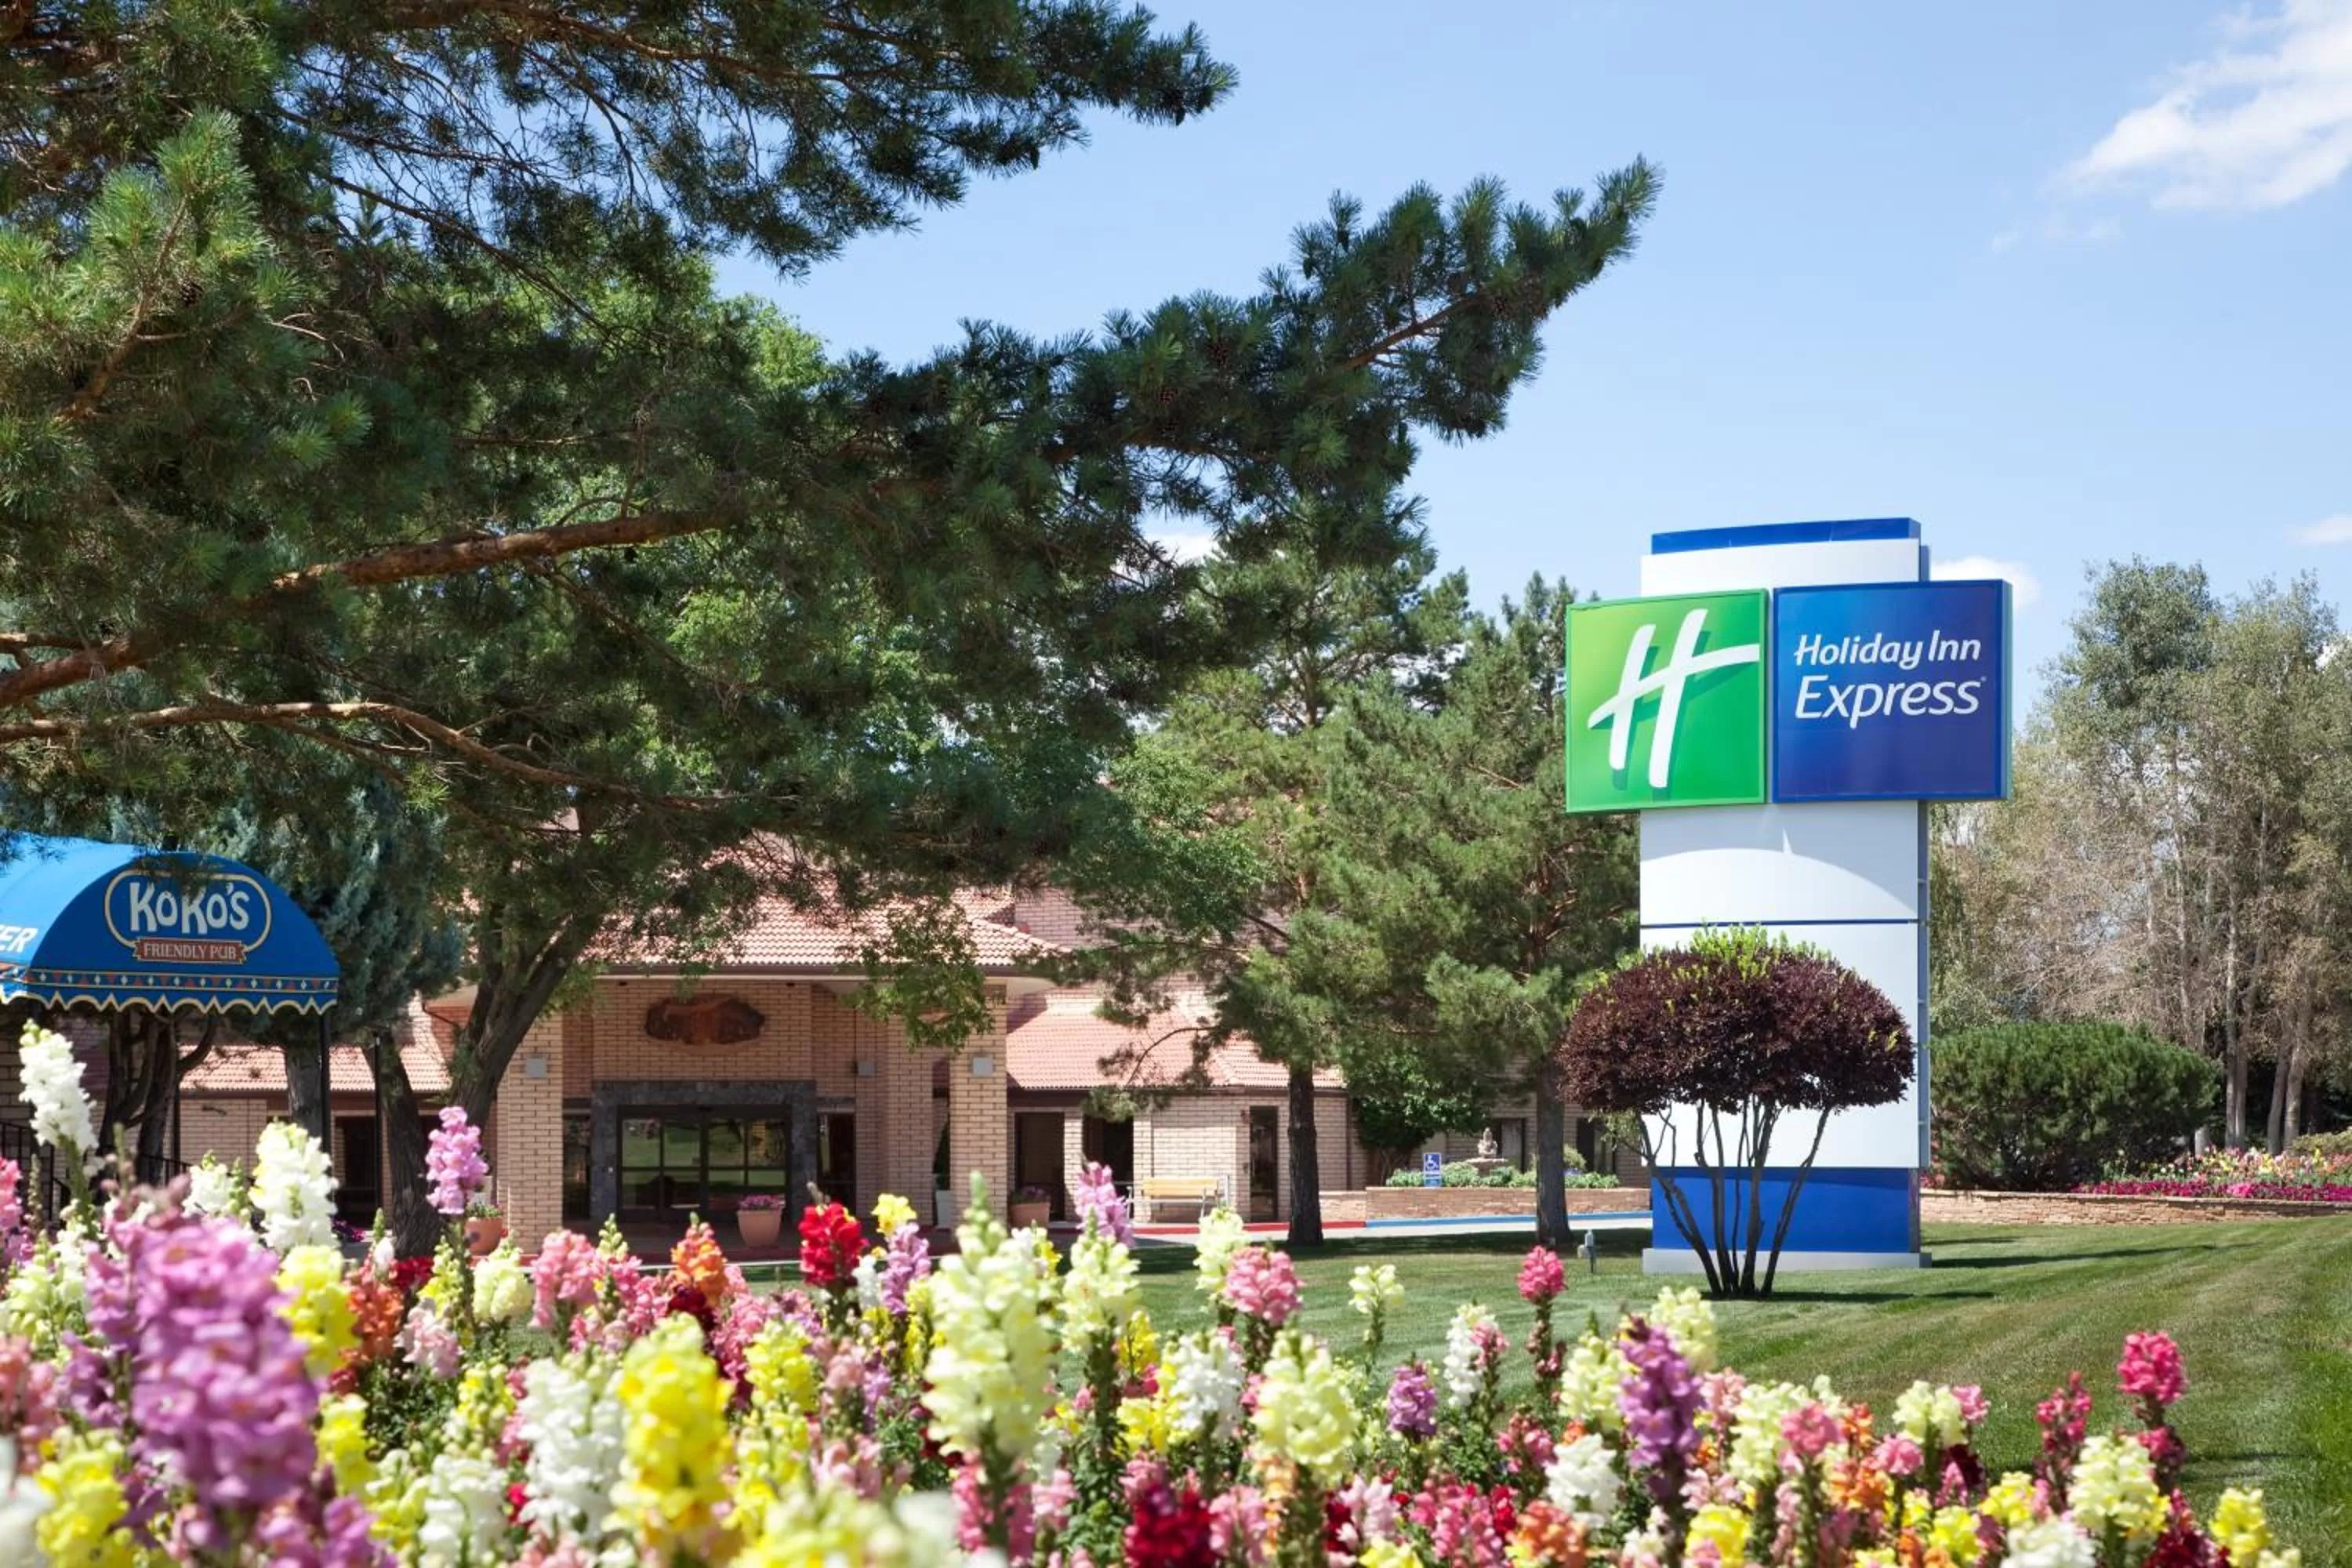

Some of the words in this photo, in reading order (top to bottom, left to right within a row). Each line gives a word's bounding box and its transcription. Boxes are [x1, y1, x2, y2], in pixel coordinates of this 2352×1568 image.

[1793, 632, 1923, 670] Holiday
[1928, 630, 1981, 662] Inn
[1795, 675, 1981, 729] Express
[0, 925, 38, 953] ER
[143, 943, 209, 958] FRIENDLY
[210, 945, 236, 960] PUB
